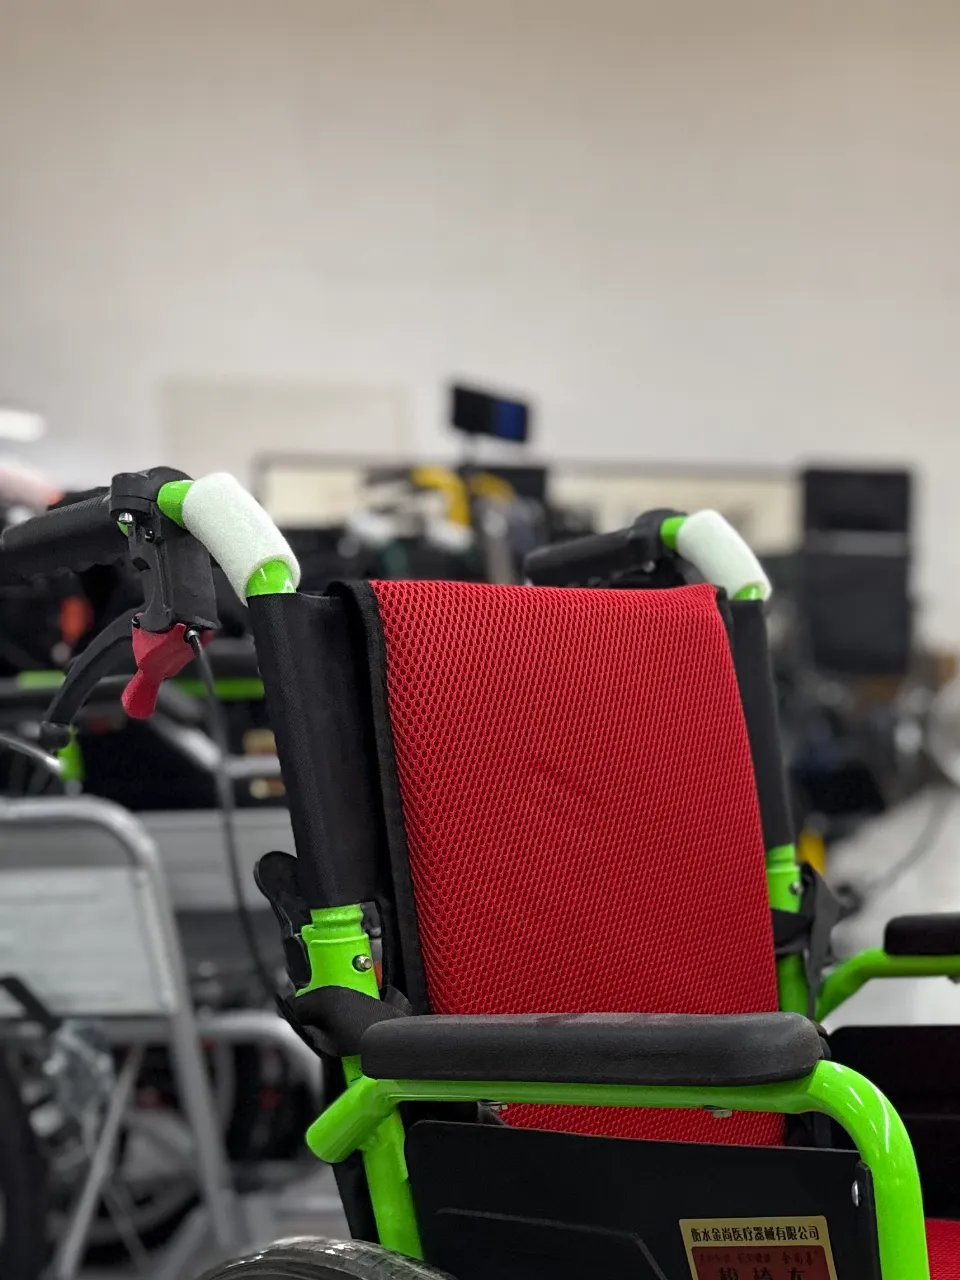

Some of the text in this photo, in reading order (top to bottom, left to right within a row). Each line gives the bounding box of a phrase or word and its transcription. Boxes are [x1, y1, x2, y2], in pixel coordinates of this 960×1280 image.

[690, 1226, 820, 1242] 衡水金尚医疗器械有限公司
